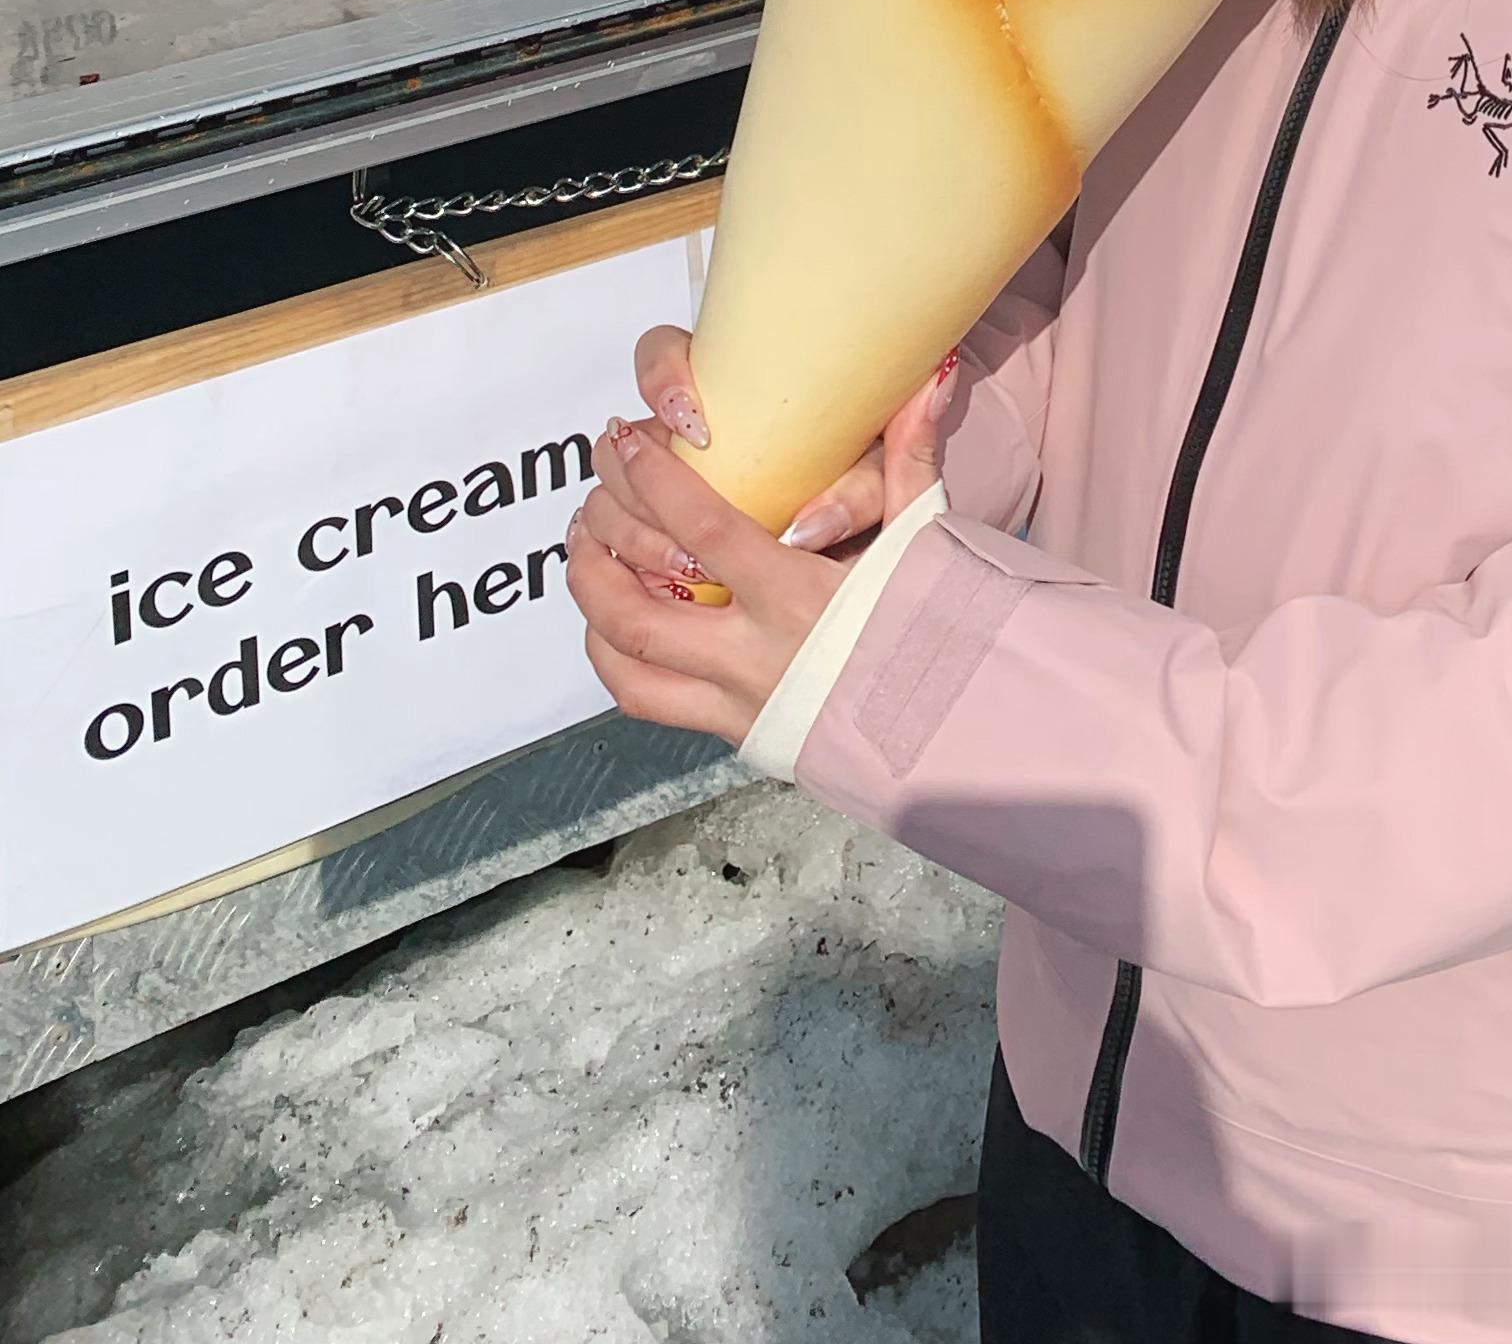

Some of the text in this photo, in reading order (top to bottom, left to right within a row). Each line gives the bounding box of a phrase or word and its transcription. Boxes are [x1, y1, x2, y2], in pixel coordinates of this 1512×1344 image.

[109, 431, 596, 645] ice cream
[83, 540, 570, 761] order her
